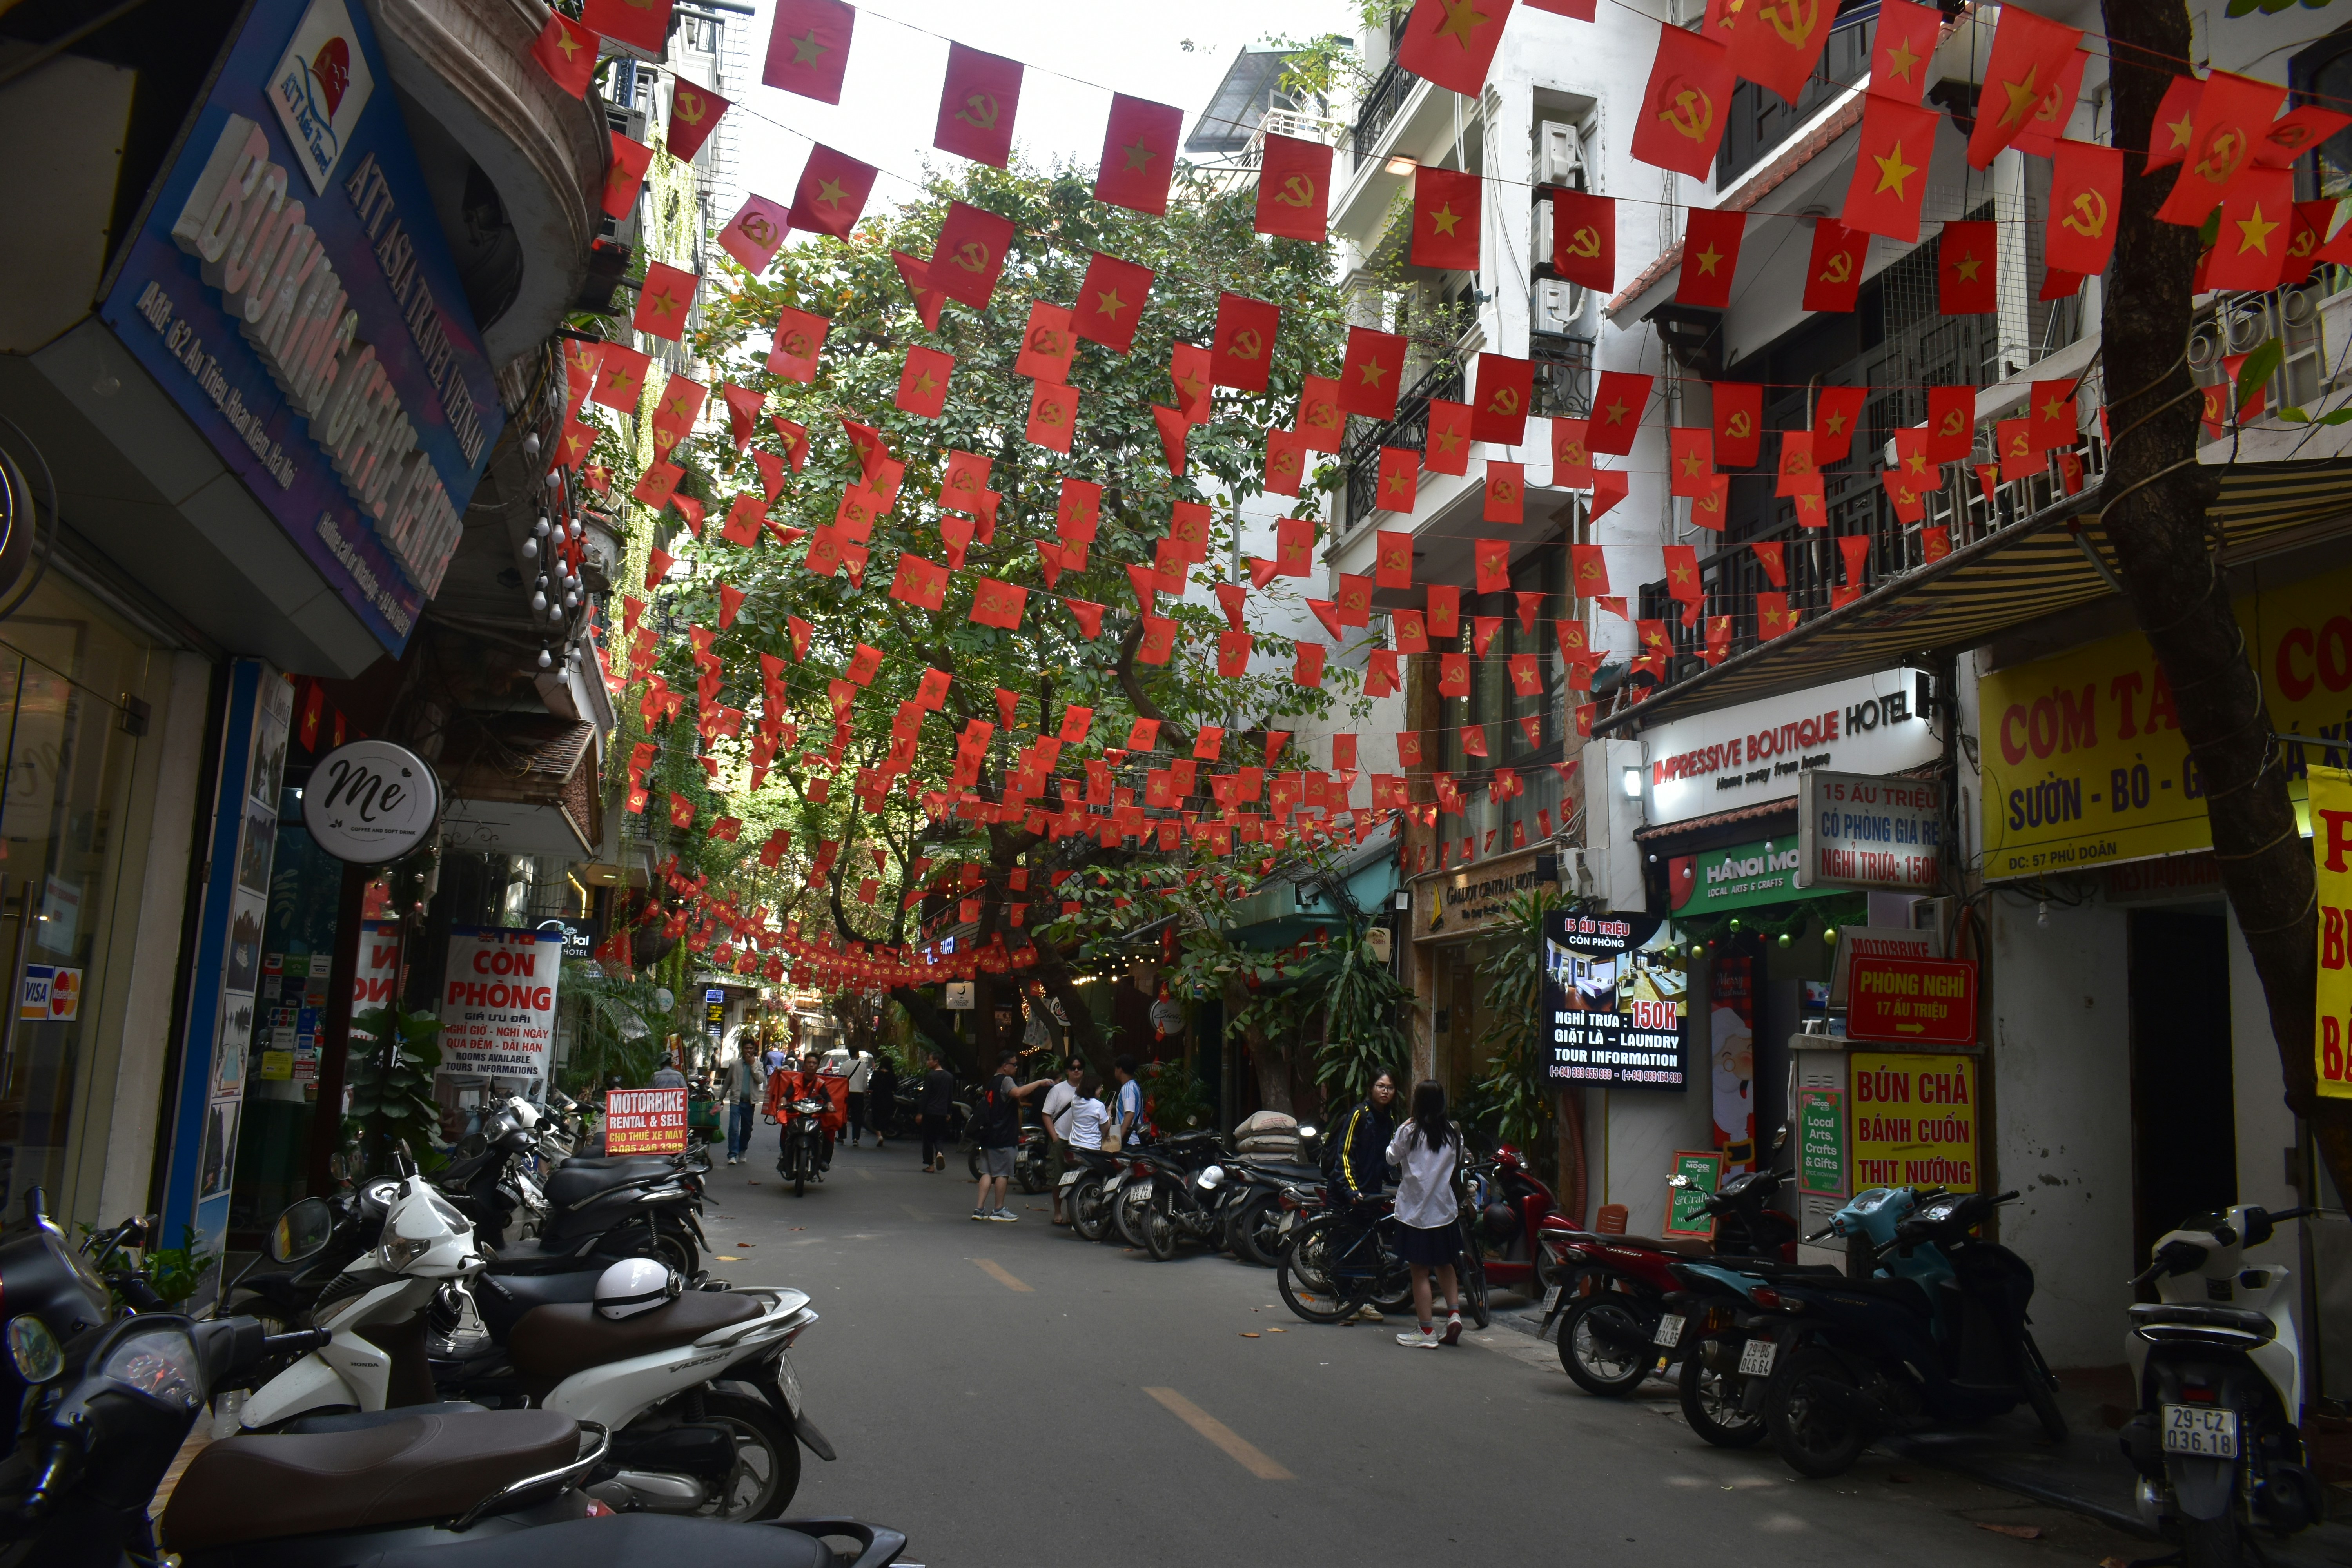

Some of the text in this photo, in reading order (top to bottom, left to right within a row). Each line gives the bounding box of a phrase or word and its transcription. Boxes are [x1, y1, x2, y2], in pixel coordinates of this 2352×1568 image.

[281, 73, 333, 176] ATT Asia Travel
[346, 151, 486, 470] ATT ASIA TRAVEL VIETNAM
[182, 116, 464, 601] BOOKING OFFICE CENTER
[136, 281, 298, 491] Add: 62 Au Trieu, Hoan Kiem, Ha Noi
[316, 511, 341, 552] Hotline
[337, 541, 354, 565] call
[346, 553, 358, 572] or
[2000, 682, 2099, 766] CƠM
[1653, 690, 1912, 786] IMPRESSIVE BOUTIQUE HOTEL
[1716, 751, 1831, 791] Home away from home
[325, 759, 406, 822] Me
[1823, 781, 1938, 811] 15 ẤU TRIỆU
[2009, 771, 2082, 831] SƯỜN
[2111, 752, 2150, 813] BÒ
[1821, 807, 1939, 846] CÓ PHÒNG GIÁ RẺ
[1821, 841, 1940, 885] NGHỈ TRƯA: 150K
[2009, 840, 2117, 870] ĐC: 57 PHỦ DOÃN
[1706, 856, 1764, 884] HANOI
[1446, 877, 1515, 904] GALLIOT CENTRAL
[1707, 877, 1784, 898] LOCAL ARTS & CRAFTS
[1564, 915, 1631, 938] 15 ẤU TRIỆU
[1568, 934, 1625, 948] CÒN PHÒNG
[473, 947, 535, 977] CÒN
[25, 982, 47, 1002] VISA
[1716, 972, 1743, 989] Merry
[1860, 967, 1966, 998] PHÒNG NGHỈ
[448, 980, 551, 1011] PHÒNG
[1713, 987, 1746, 998] Christmas
[465, 1011, 485, 1020] GIÁ
[510, 1014, 531, 1024] ĐÃI
[1555, 1009, 1620, 1028] NGHỈ TRƯA
[1631, 999, 1677, 1031] 150K
[1876, 997, 1948, 1022] 17 ẤU TRIỆU
[443, 1021, 549, 1039] NGHỈ GIỜ NGHỈ NGÀY
[1554, 1027, 1679, 1049] GIẶT LÀ LAUNDRY
[446, 1037, 543, 1054] QUA ĐÊM DÀI HẠN
[446, 1062, 538, 1075] TOURS INFORMATIONS
[456, 1052, 531, 1064] ROOMS AVAILABLE
[1554, 1048, 1678, 1067] TOUR INFORMATION
[1549, 1065, 1682, 1084] (+84) 393 955 968 (+84) 988 164 398
[1857, 1063, 1970, 1105] BÚN CHẢ
[610, 1091, 684, 1114] MOTORBIKE
[610, 1115, 647, 1129] RENTAL
[649, 1115, 657, 1127] &
[660, 1114, 684, 1127] SELL
[1808, 1116, 1834, 1128] Local
[1858, 1111, 1970, 1144] BÁNH CUỐN
[609, 1128, 684, 1142] CHO THUÊ XE MÁY
[1809, 1129, 1833, 1142] Arts,
[618, 1142, 684, 1153] 085 446 3388
[1806, 1142, 1837, 1156] Crafts
[1806, 1156, 1838, 1170] & Gifts
[1858, 1155, 1971, 1188] THỊT NƯỚNG
[1606, 1247, 1642, 1257] VISION
[1655, 1329, 1679, 1345] 024.95
[668, 1350, 733, 1373] VISION
[1746, 1342, 1771, 1358] 29-BG
[1740, 1357, 1769, 1374] 046.64
[2173, 1408, 2224, 1432] 29-C2
[2167, 1430, 2231, 1454] 036.18
